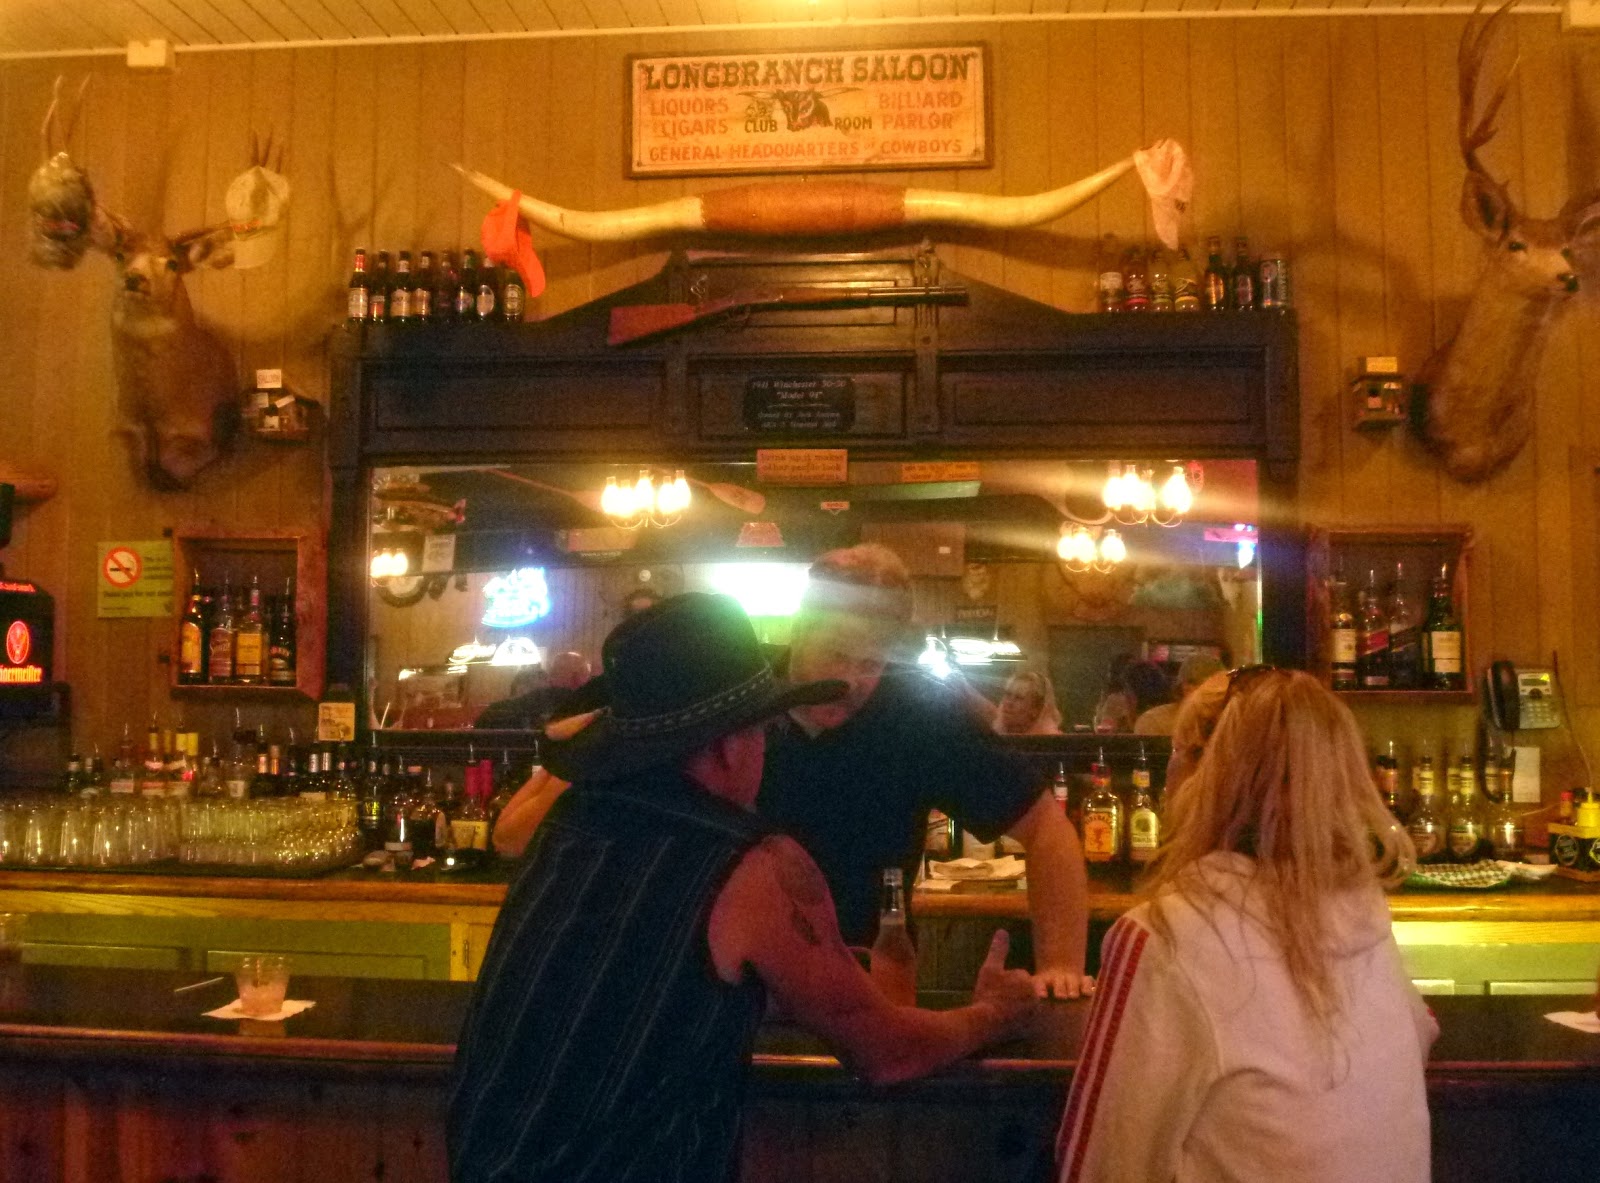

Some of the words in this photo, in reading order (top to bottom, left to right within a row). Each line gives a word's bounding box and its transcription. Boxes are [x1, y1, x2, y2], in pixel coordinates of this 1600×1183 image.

[645, 57, 844, 90] LONGBRANCH
[853, 53, 969, 82] SALOON
[650, 97, 729, 116] LIQUORS
[879, 91, 963, 110] BILLIARD
[744, 119, 778, 133] CLUB
[834, 116, 872, 130] ROOM
[881, 112, 953, 130] PARLOR
[649, 144, 720, 161] GENERAL
[730, 141, 860, 159] HEADQUARTERS
[881, 139, 962, 154] COWBOYS
